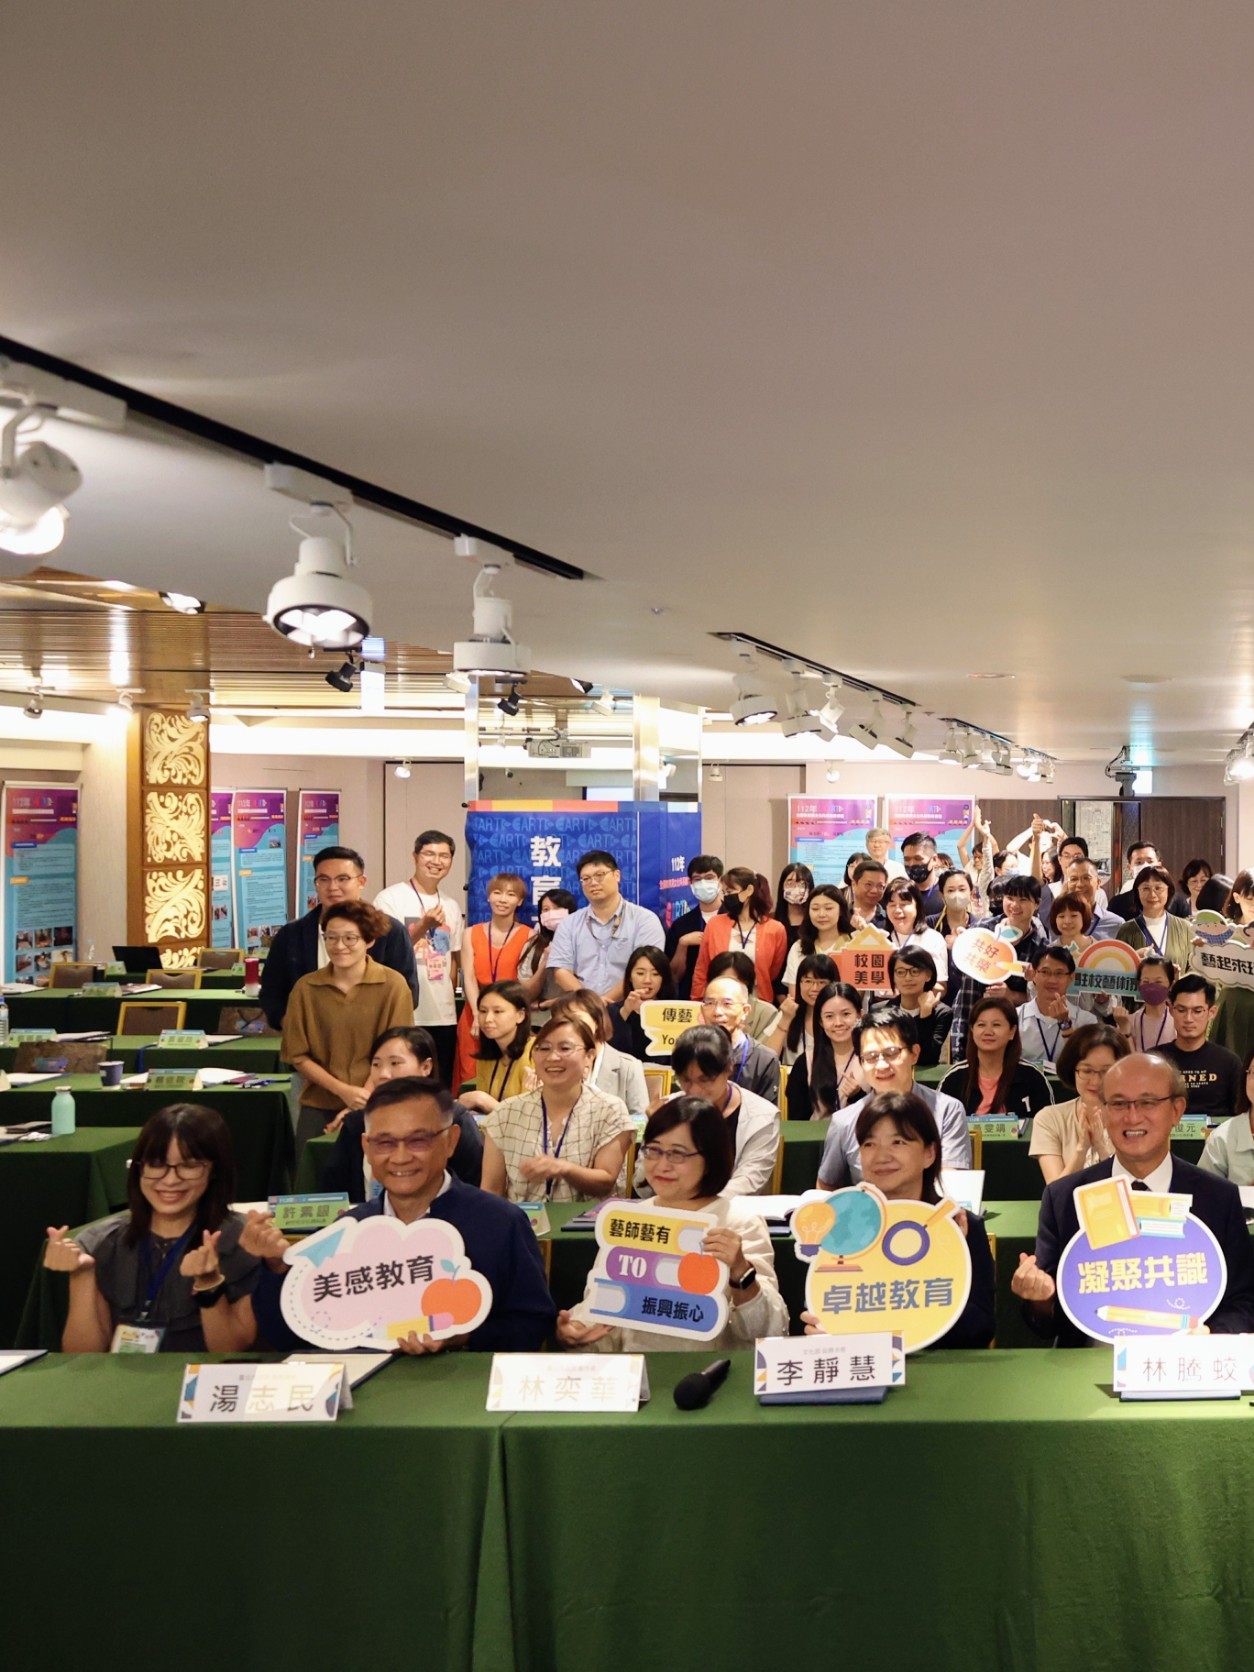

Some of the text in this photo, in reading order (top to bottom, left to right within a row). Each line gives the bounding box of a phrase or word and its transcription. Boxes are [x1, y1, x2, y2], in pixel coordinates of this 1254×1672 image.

[855, 953, 885, 968] 校園
[855, 970, 885, 985] 美學
[609, 1218, 671, 1244] 藝師藝有
[313, 1255, 434, 1302] 美感教育
[618, 1254, 647, 1278] TO
[1078, 1252, 1208, 1294] 凝聚共識
[641, 1296, 704, 1322] 振興振心
[821, 1277, 954, 1314] 卓越教育
[776, 1355, 876, 1386] 李靜慧
[210, 1385, 314, 1413] 湯志民
[519, 1375, 618, 1403] 林奕華
